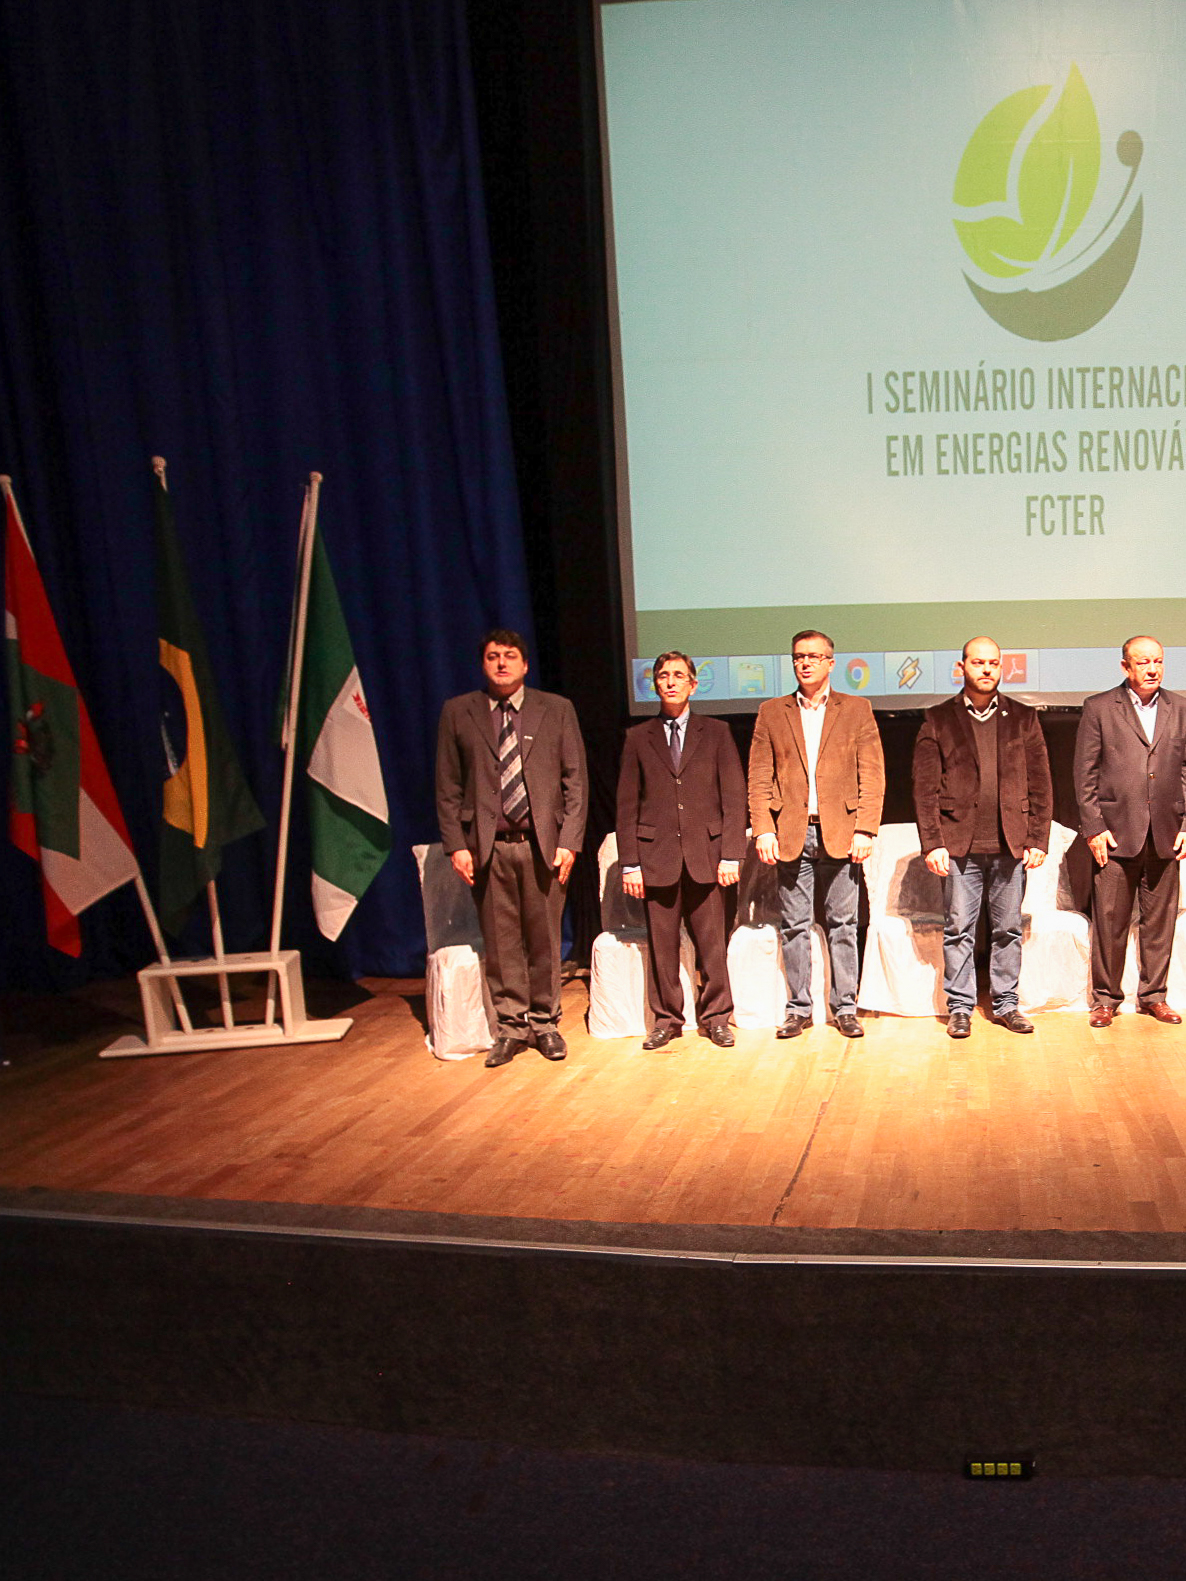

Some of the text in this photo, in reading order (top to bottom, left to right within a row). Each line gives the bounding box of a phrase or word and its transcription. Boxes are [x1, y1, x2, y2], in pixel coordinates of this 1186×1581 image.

[866, 372, 874, 414] I
[884, 360, 1036, 414] SEMINÁRIO
[886, 434, 925, 477] EM
[935, 429, 1068, 475] ENERGIAS
[1025, 494, 1106, 537] FCTER
